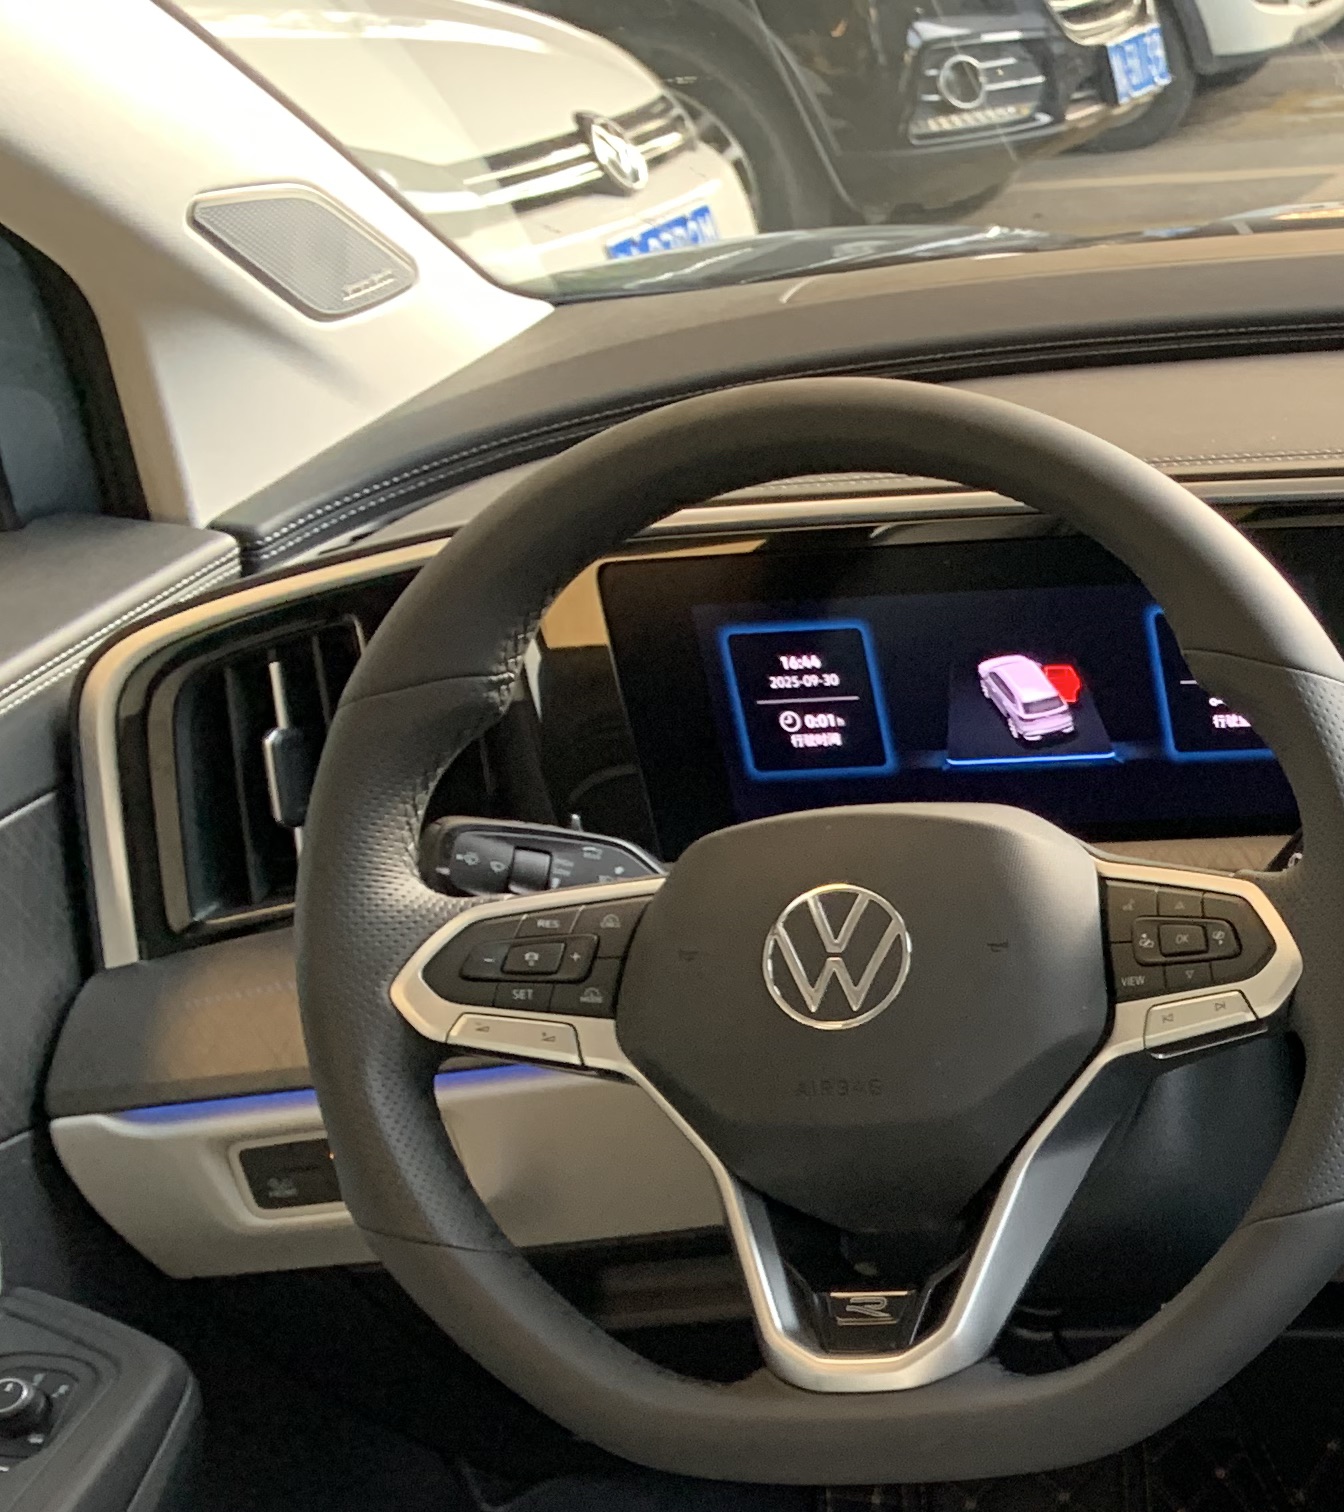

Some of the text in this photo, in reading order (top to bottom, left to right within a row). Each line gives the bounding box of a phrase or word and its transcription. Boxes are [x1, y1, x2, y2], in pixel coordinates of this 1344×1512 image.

[780, 654, 822, 670] 16:44
[769, 673, 840, 689] 2025-09-30
[537, 918, 560, 929] RES
[1175, 933, 1189, 945] OK
[1121, 975, 1145, 988] VIEW
[512, 988, 533, 1000] SET
